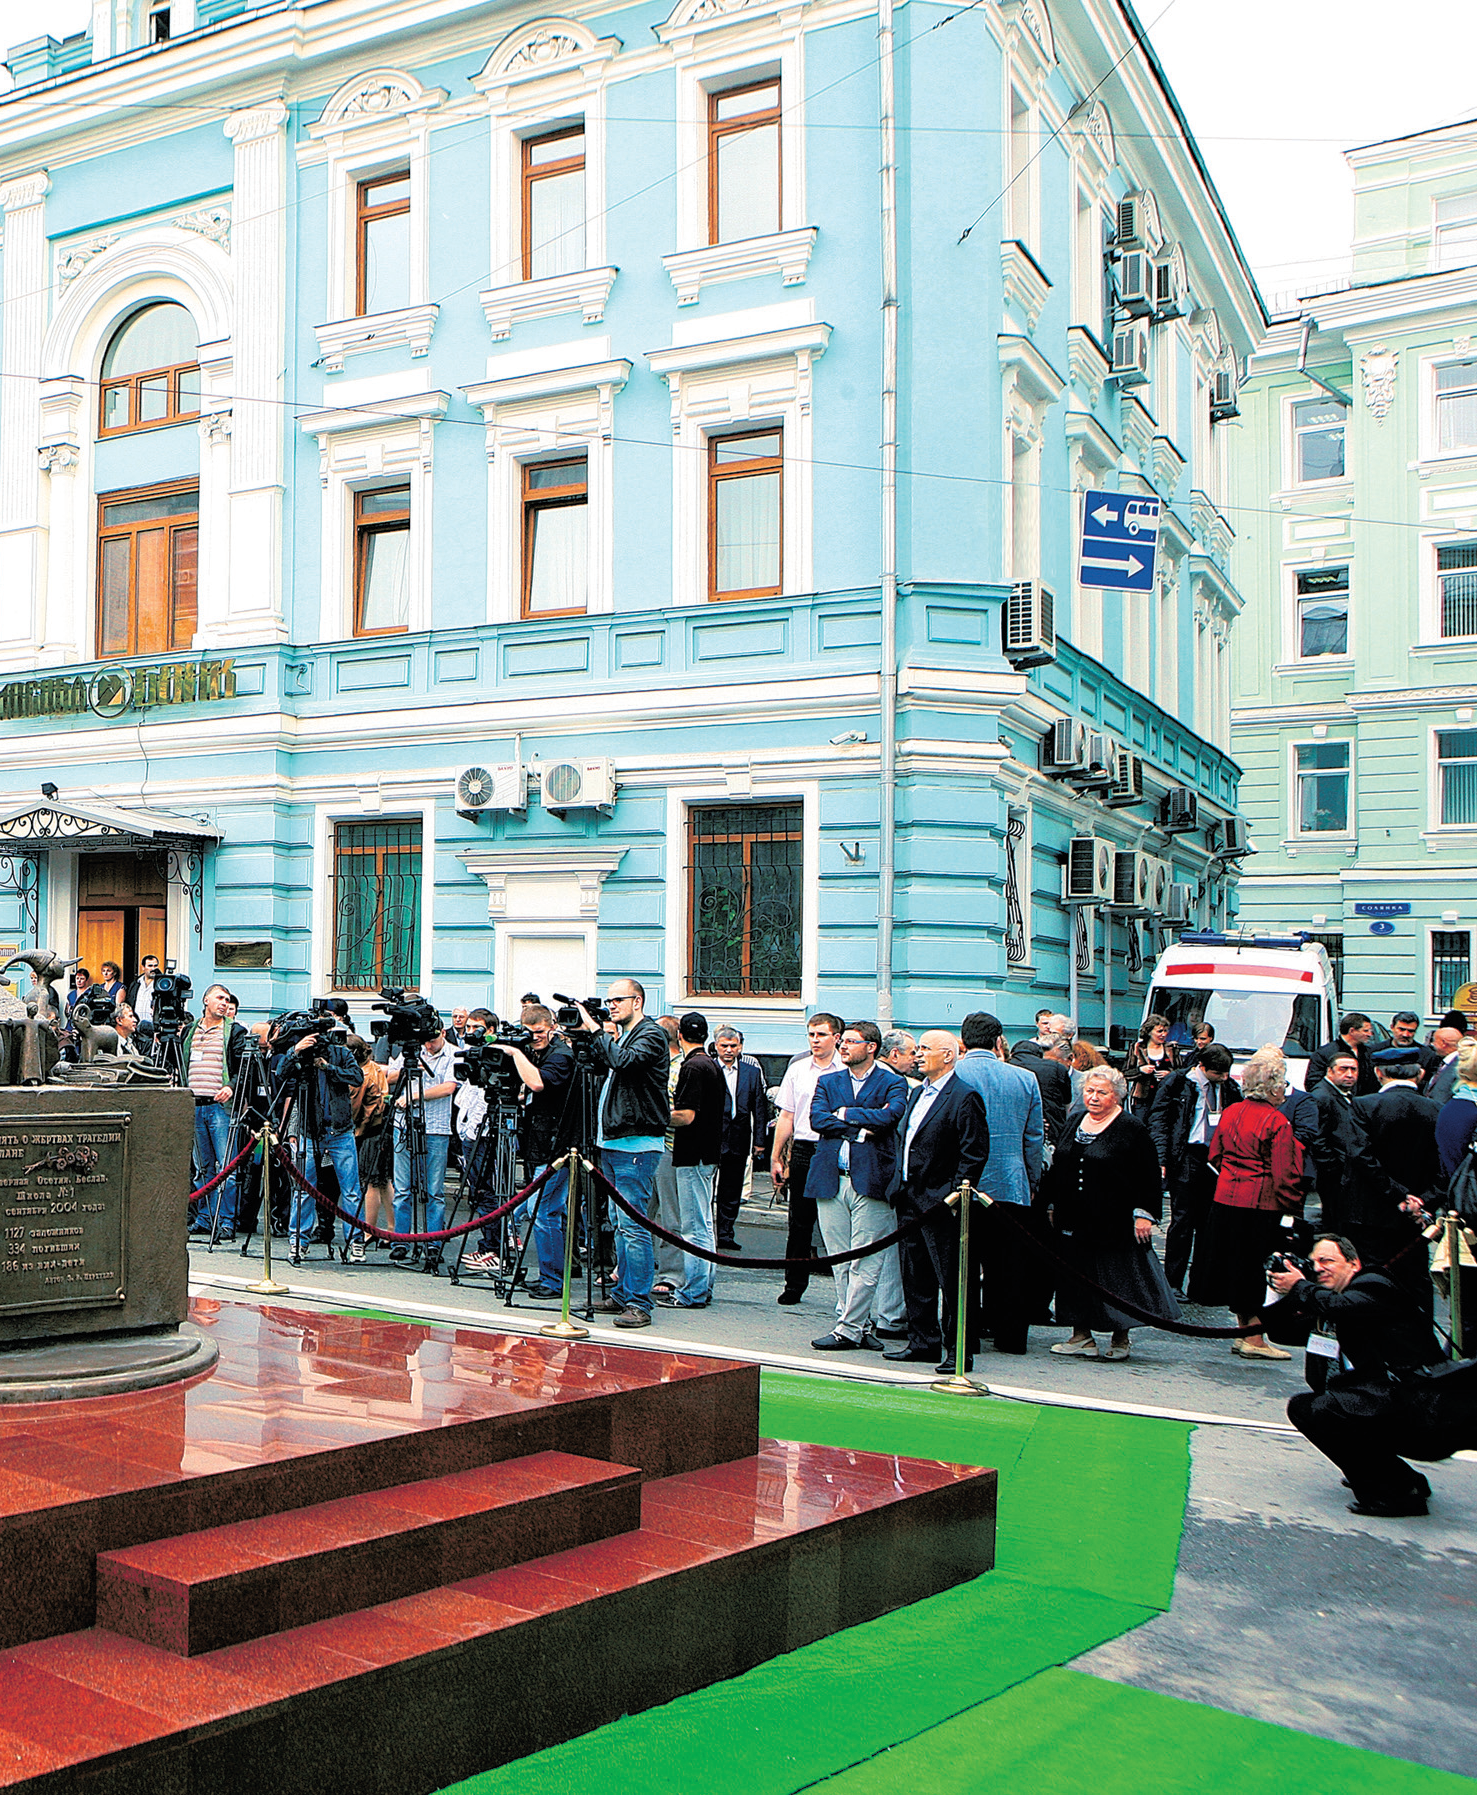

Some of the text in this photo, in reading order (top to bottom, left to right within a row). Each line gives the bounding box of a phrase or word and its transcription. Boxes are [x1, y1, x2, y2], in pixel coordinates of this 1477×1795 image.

[22, 1135, 29, 1144] О
[31, 1134, 74, 1144] ЖЕРТВАХ
[76, 1133, 121, 1144] ТРАГЕДИИ
[16, 1190, 52, 1200] Школа
[50, 1201, 78, 1214] 2004
[4, 1226, 24, 1240] 1127
[8, 1242, 26, 1255] 334
[1, 1260, 19, 1273] 186
